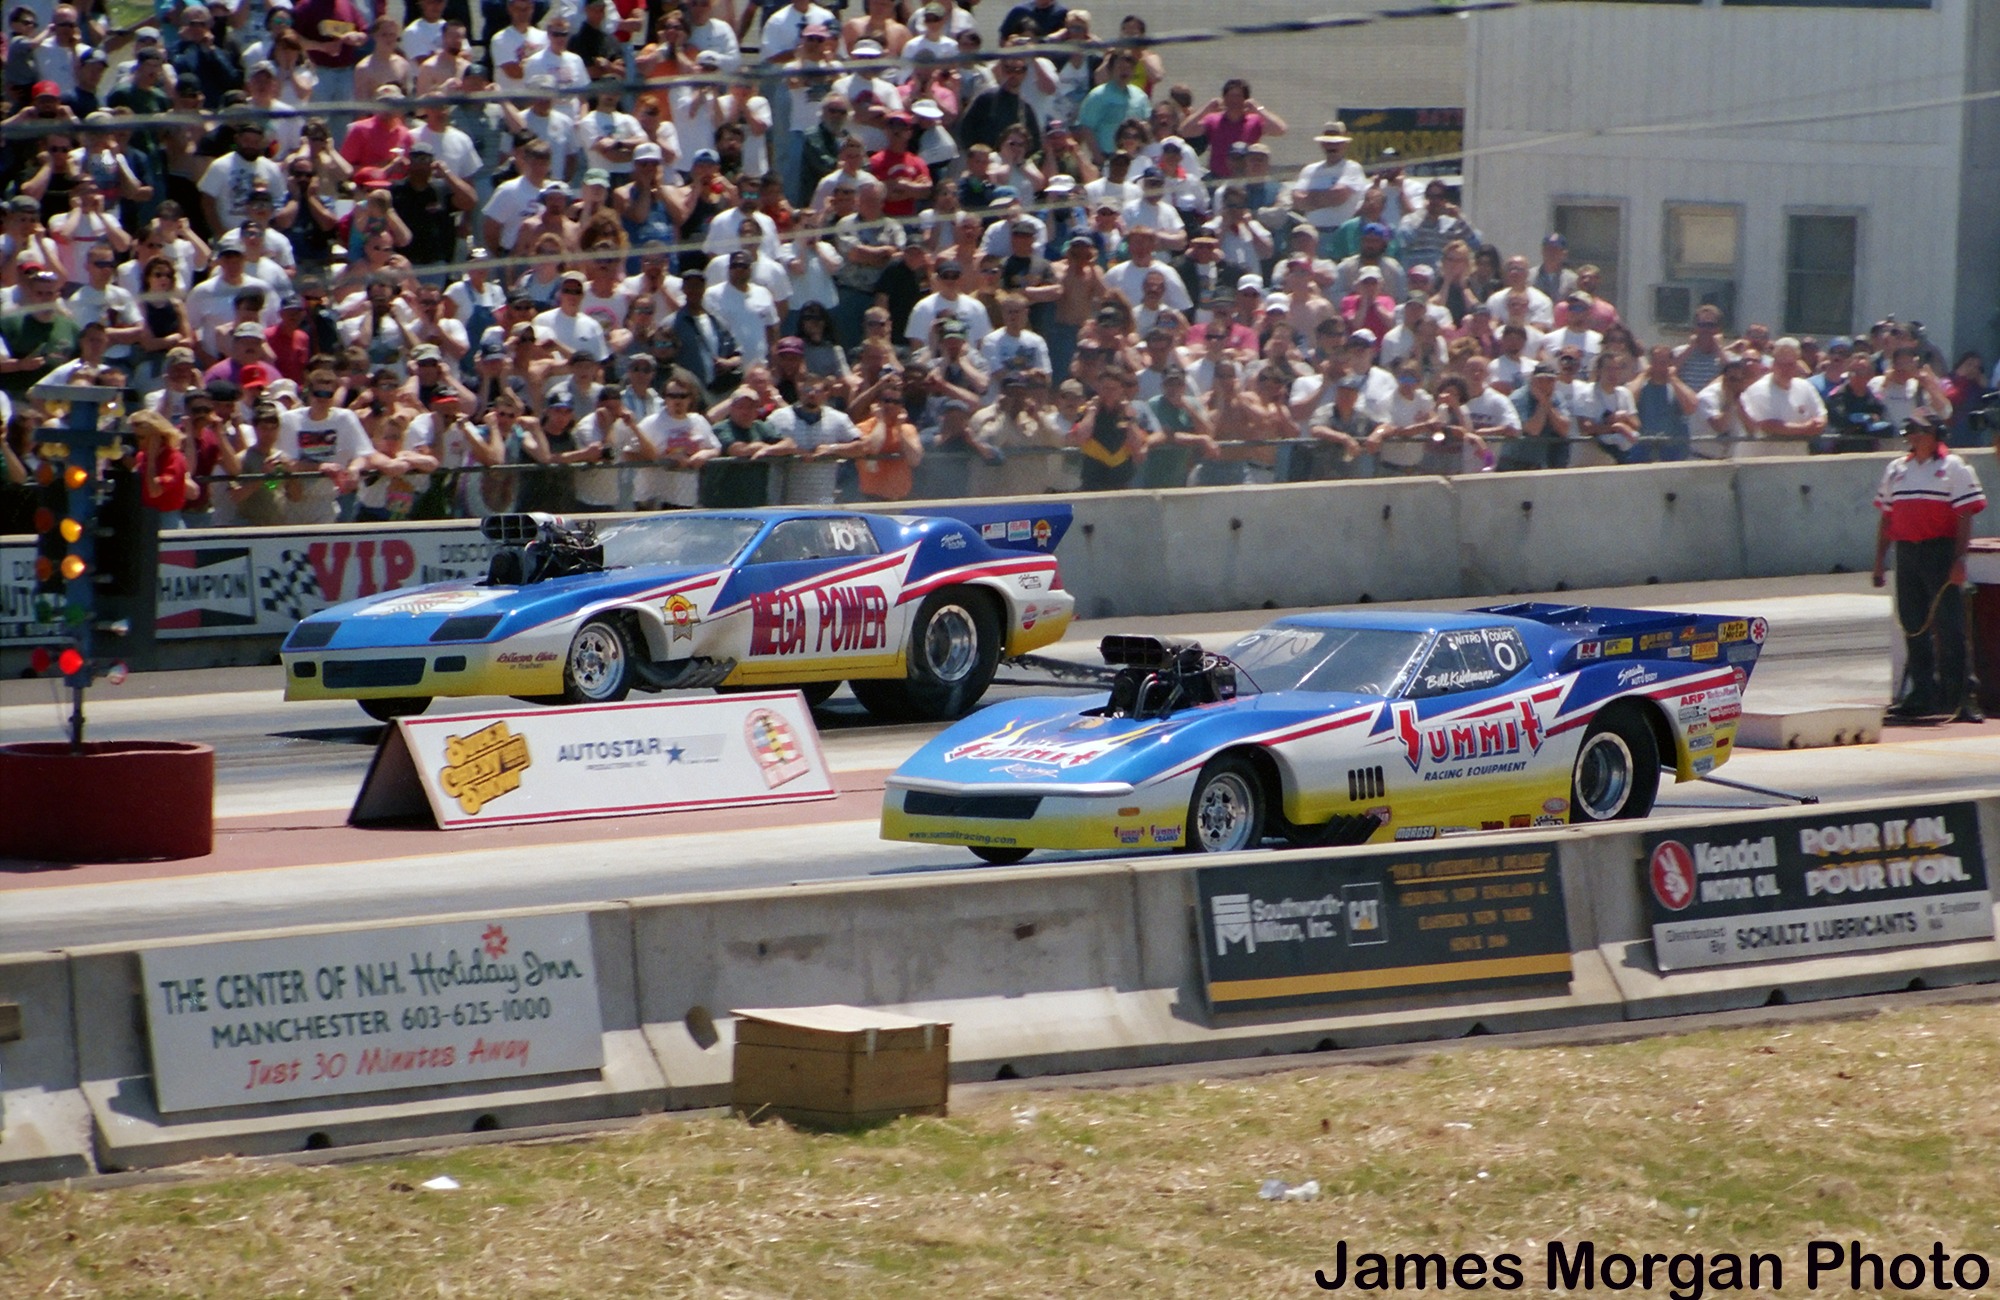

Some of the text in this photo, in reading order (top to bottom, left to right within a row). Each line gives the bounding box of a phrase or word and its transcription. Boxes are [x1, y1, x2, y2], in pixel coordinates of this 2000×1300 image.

[831, 526, 856, 551] 10
[158, 574, 247, 602] HAMPION
[309, 539, 415, 602] VIP
[749, 585, 888, 656] MEGA POWER
[1455, 631, 1514, 645] NITRO COUPE
[1424, 672, 1449, 689] Bill
[1681, 693, 1706, 707] ARP
[557, 737, 662, 762] AUTOSTAR
[1424, 761, 1527, 781] RACING EQUIPMENT
[1396, 827, 1436, 840] MOROSO
[1801, 823, 1881, 855] POUR
[1883, 819, 1908, 848] IT
[1694, 836, 1778, 874] Kendall
[1805, 861, 1887, 896] POUR
[1886, 858, 1912, 887] IT
[1736, 923, 1810, 950] SCHULTZ
[1814, 912, 1917, 942] LUBRICANTS
[160, 949, 583, 1014] THE CENTER OF N.H. Holiday Inn
[212, 997, 552, 1049] MANCHESTER 603-625-1000
[246, 1037, 530, 1090] Just 30 Minutes Away
